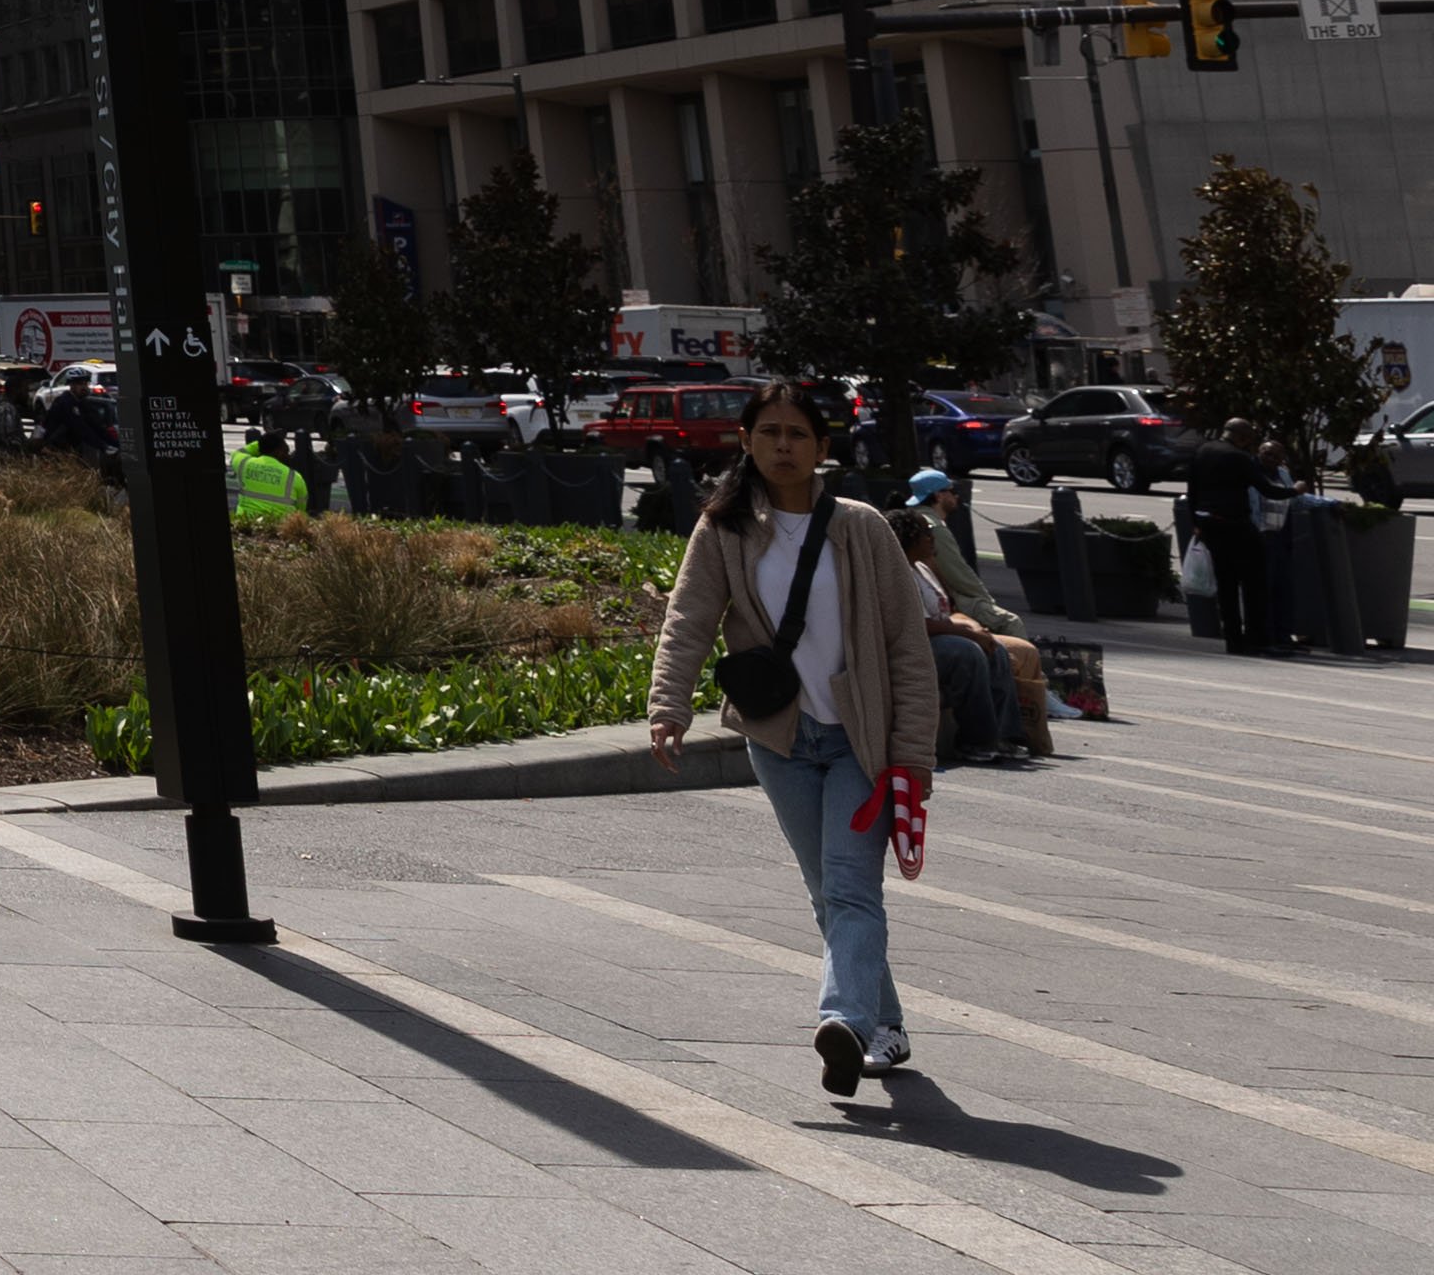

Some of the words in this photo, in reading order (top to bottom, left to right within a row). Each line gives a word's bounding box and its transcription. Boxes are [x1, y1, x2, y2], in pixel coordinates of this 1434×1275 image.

[1309, 25, 1340, 38] THE
[1346, 24, 1377, 37] BOX
[93, 75, 110, 118] St
[102, 160, 122, 248] City
[112, 264, 134, 352] Hall
[150, 411, 173, 420] 15TH
[151, 421, 172, 430] CITY
[174, 421, 199, 430] HALL
[153, 430, 208, 439] ACCESSIBLE
[153, 440, 202, 449] ENTRANCE
[154, 449, 187, 458] AHEAD
